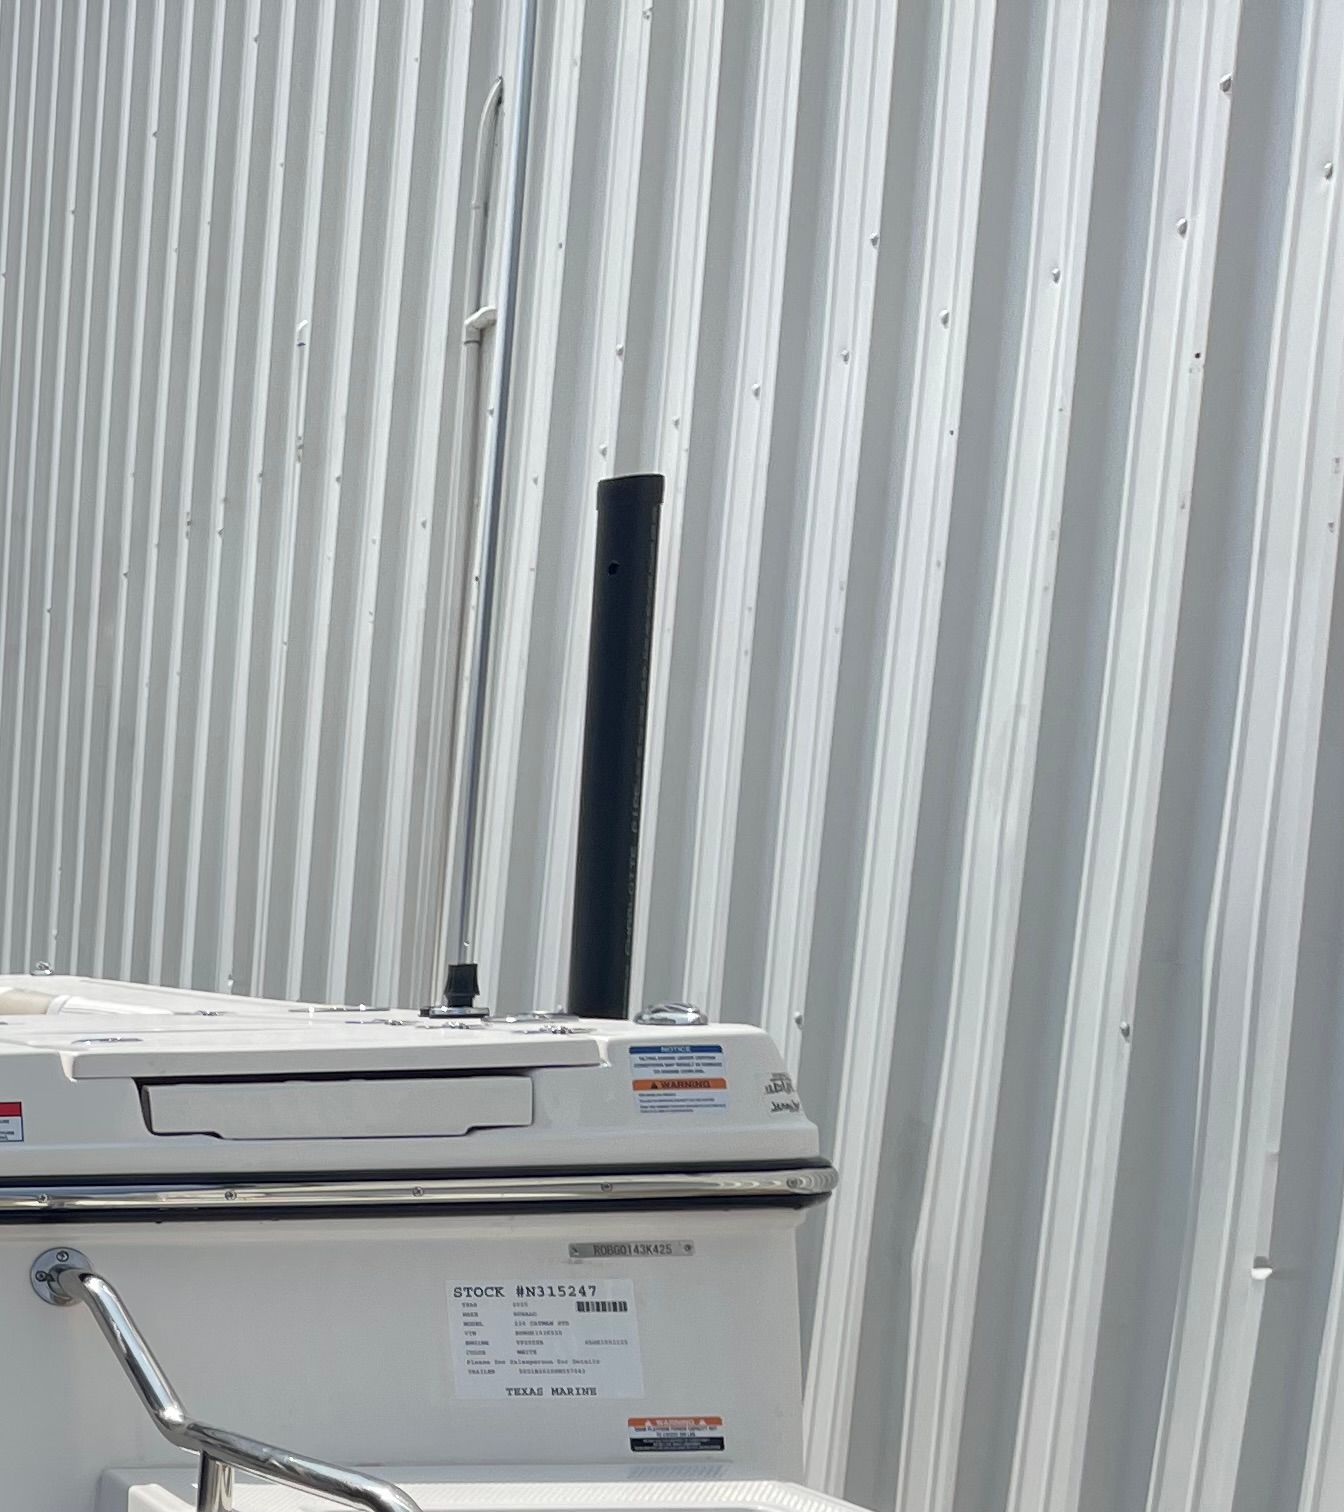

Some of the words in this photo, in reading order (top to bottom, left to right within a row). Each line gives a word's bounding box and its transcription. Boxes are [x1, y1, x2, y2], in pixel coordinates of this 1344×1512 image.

[453, 1286, 505, 1298] STOCK
[516, 1285, 597, 1297] #N315247
[506, 1387, 543, 1396] TEXAS
[551, 1387, 597, 1396] MARINE
